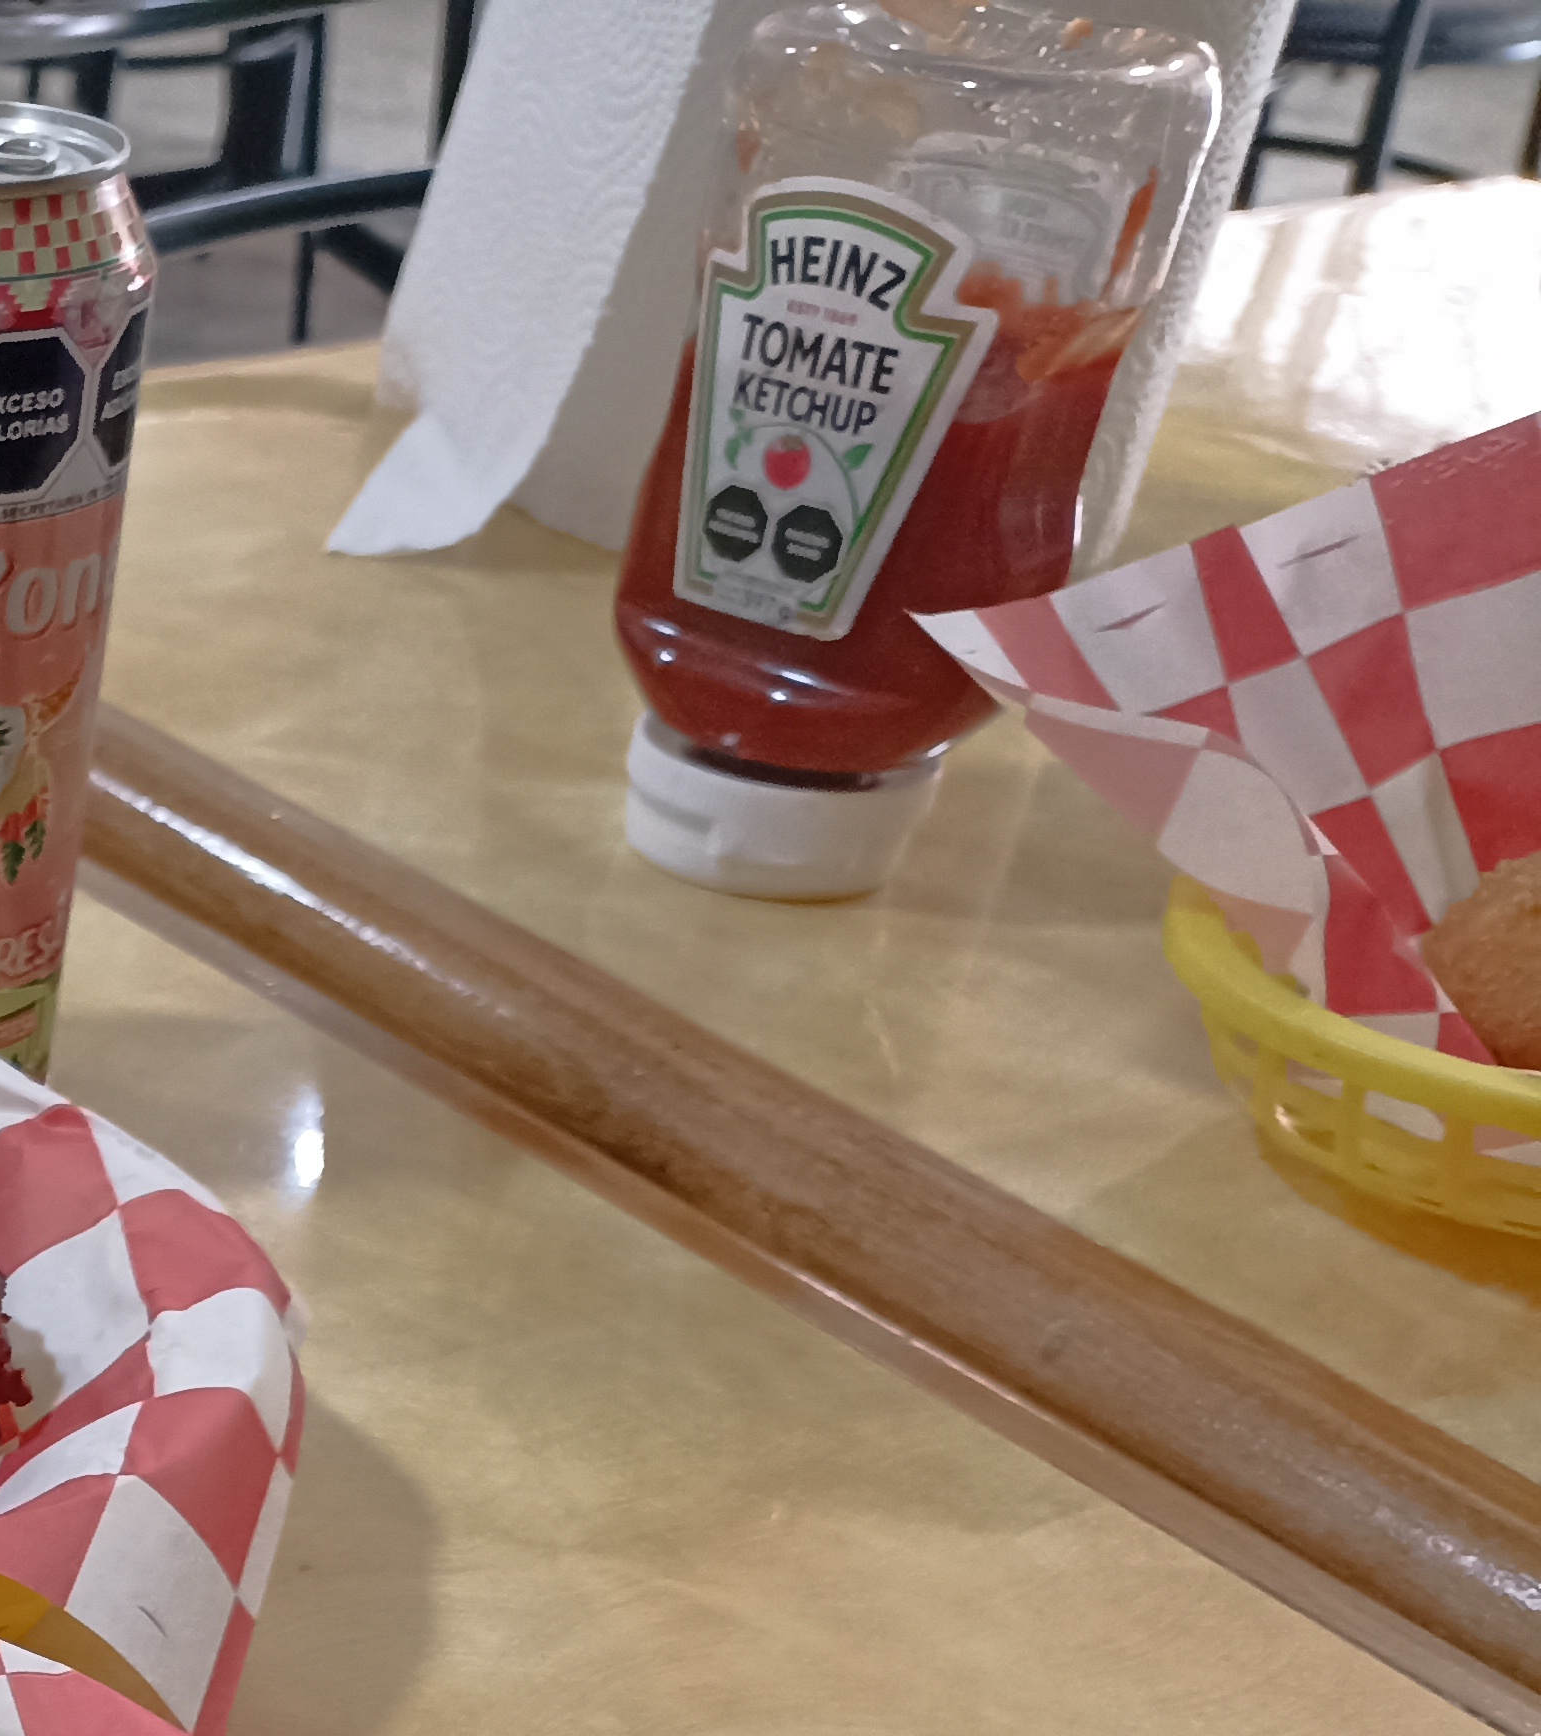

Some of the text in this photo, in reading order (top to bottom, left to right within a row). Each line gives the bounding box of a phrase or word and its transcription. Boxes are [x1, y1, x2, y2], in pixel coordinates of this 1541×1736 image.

[770, 236, 907, 312] HEINZ
[742, 312, 899, 394] TOMATE
[732, 368, 877, 436] KETCHUP
